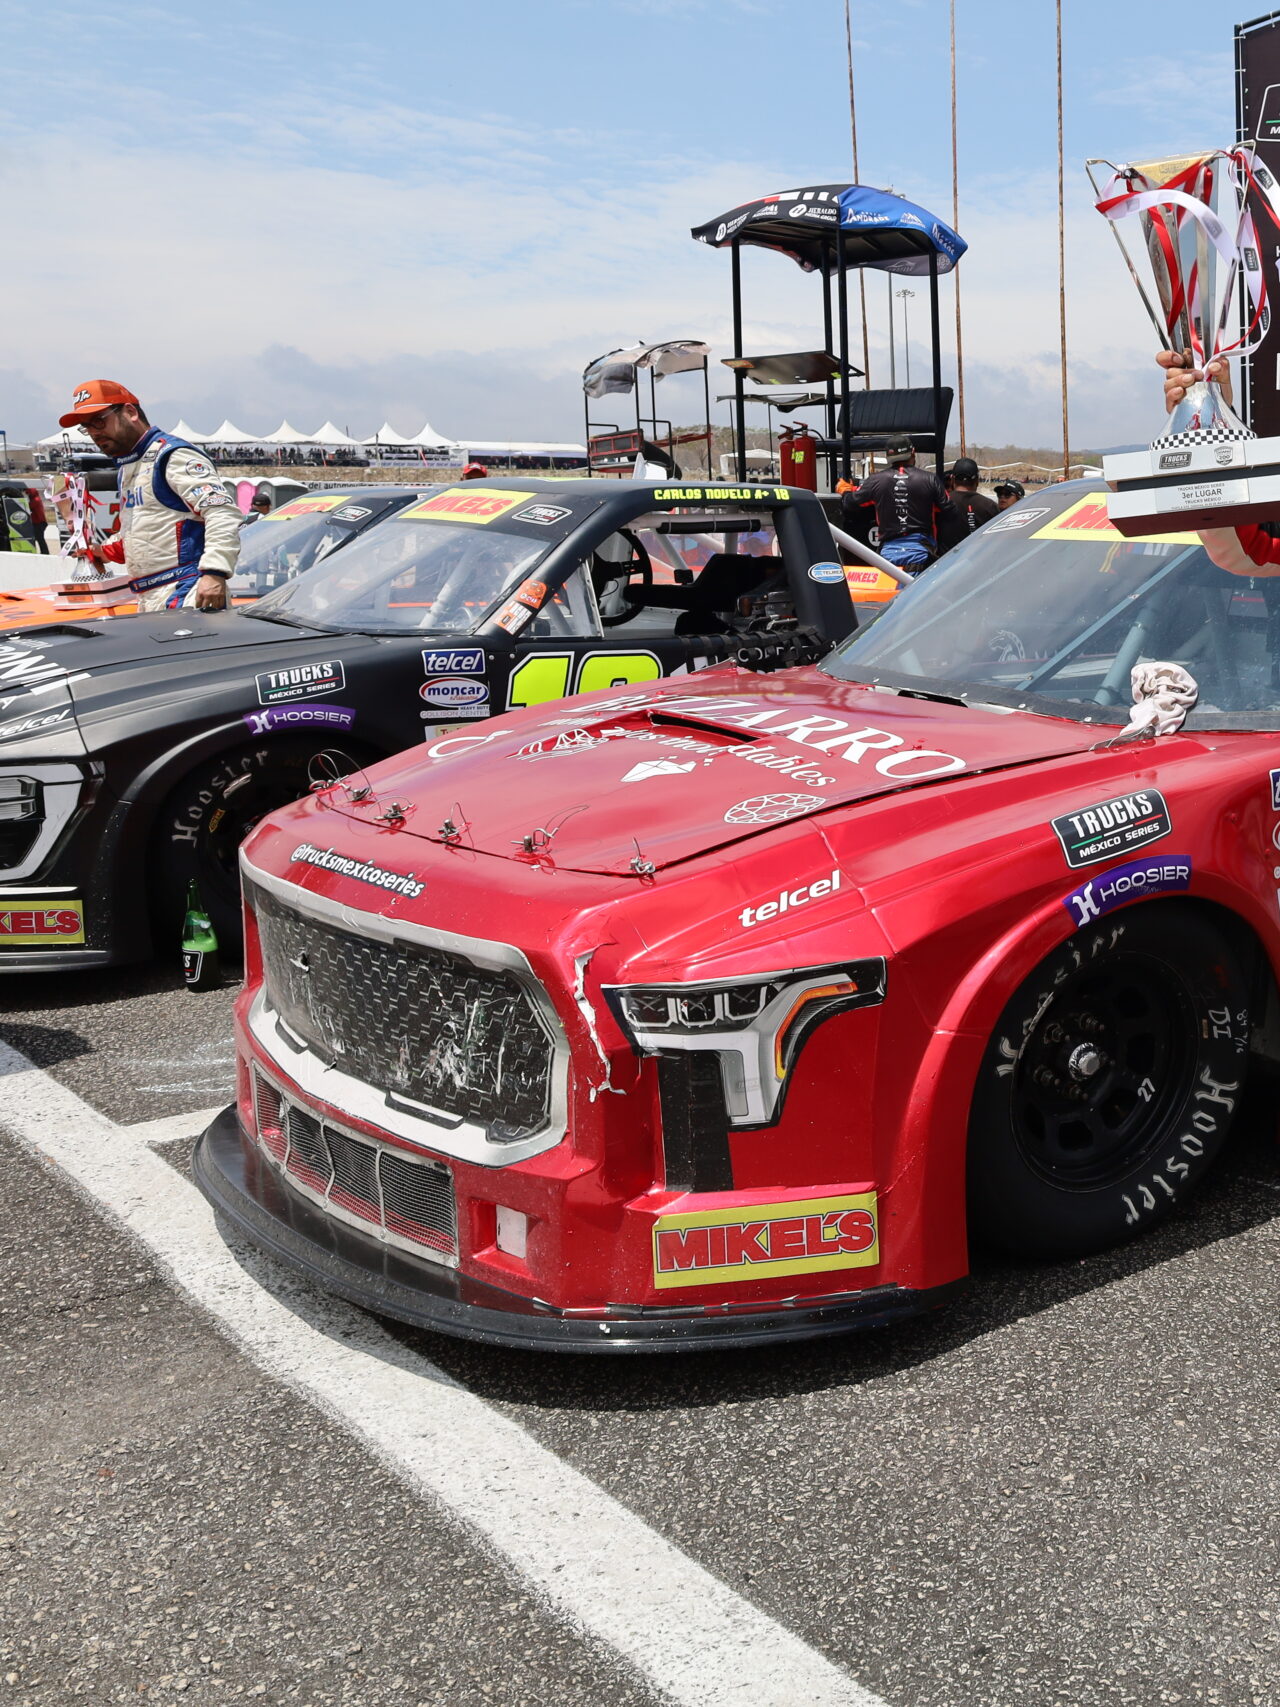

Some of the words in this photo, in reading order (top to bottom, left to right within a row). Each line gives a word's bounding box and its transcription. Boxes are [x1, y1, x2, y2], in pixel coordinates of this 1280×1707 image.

[1165, 454, 1188, 462] TRUCKS
[654, 488, 702, 500] CARLOS
[705, 488, 751, 500] NOVELO
[774, 488, 790, 500] 18
[1182, 491, 1194, 499] 3er
[1195, 488, 1223, 498] LUGAR
[426, 652, 482, 672] telcel
[267, 663, 333, 688] TRUCKS
[269, 688, 303, 700] MÉXICO
[306, 682, 336, 692] SERIES
[427, 684, 481, 697] moncar
[273, 711, 351, 724] HOOSIER
[1068, 792, 1154, 840] TRUCKS
[1079, 836, 1122, 859] MÉXICO
[1125, 822, 1161, 842] SERIES
[291, 844, 425, 897] @trucksmexicoseries
[1099, 865, 1190, 903] HOOSIER
[738, 870, 841, 928] telcel
[1138, 1078, 1155, 1102] 27
[656, 1208, 876, 1274] MIKEL'S
